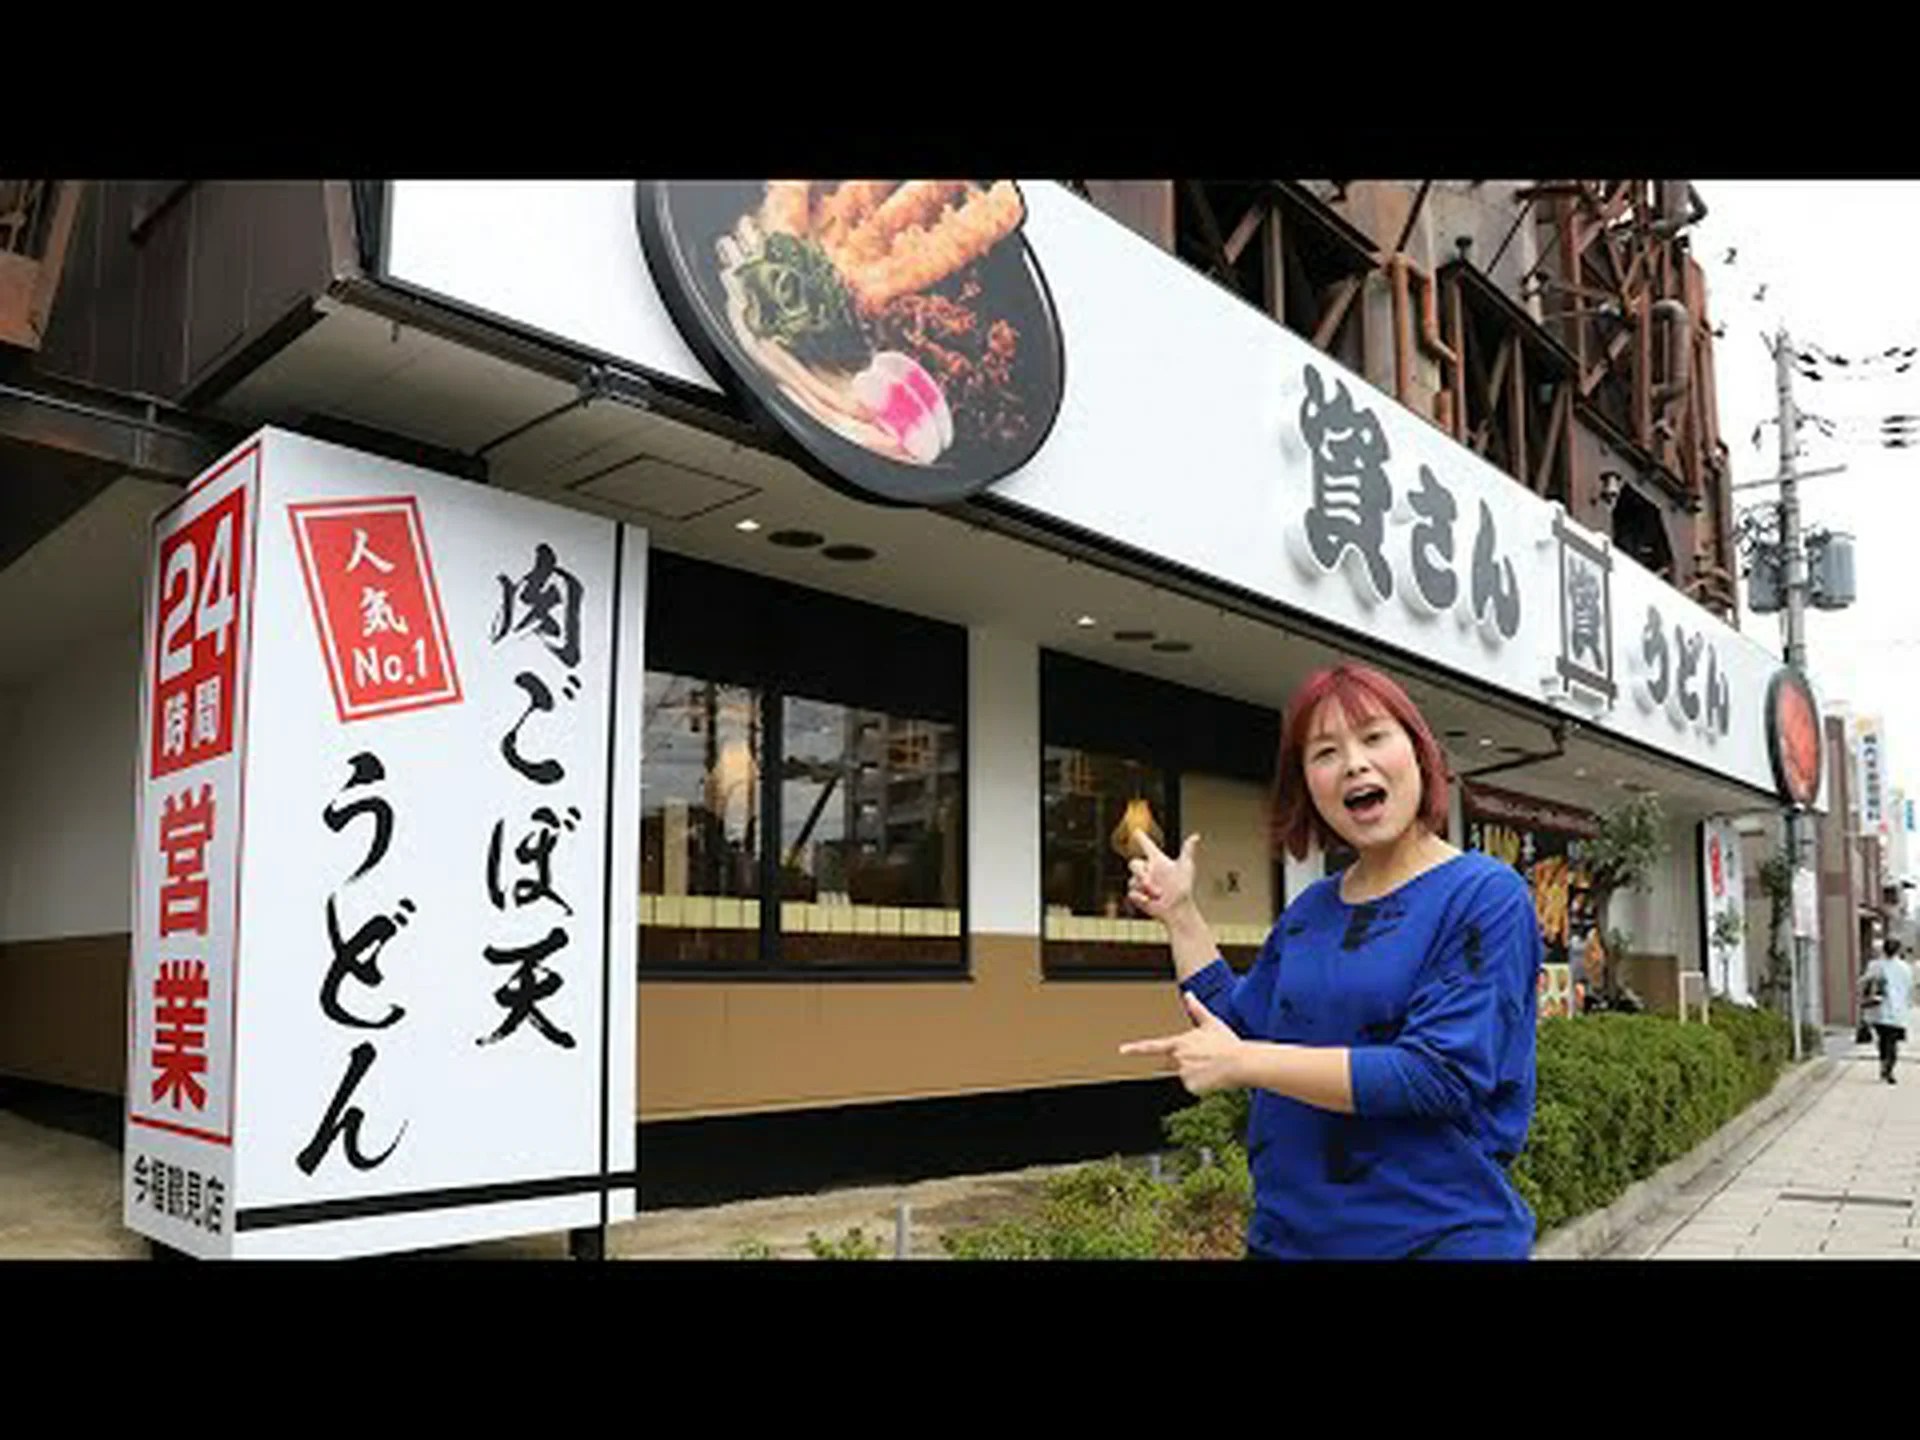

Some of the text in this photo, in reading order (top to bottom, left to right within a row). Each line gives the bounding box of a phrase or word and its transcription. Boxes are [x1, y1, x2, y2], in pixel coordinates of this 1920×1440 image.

[160, 513, 236, 684] 24
[1301, 363, 1520, 639] 資さん
[352, 638, 428, 688] No.1
[475, 543, 584, 1049] 肉ごぼ天
[1644, 606, 1730, 736] うどん
[152, 783, 216, 1111] 営業
[296, 752, 416, 1176] うどん
